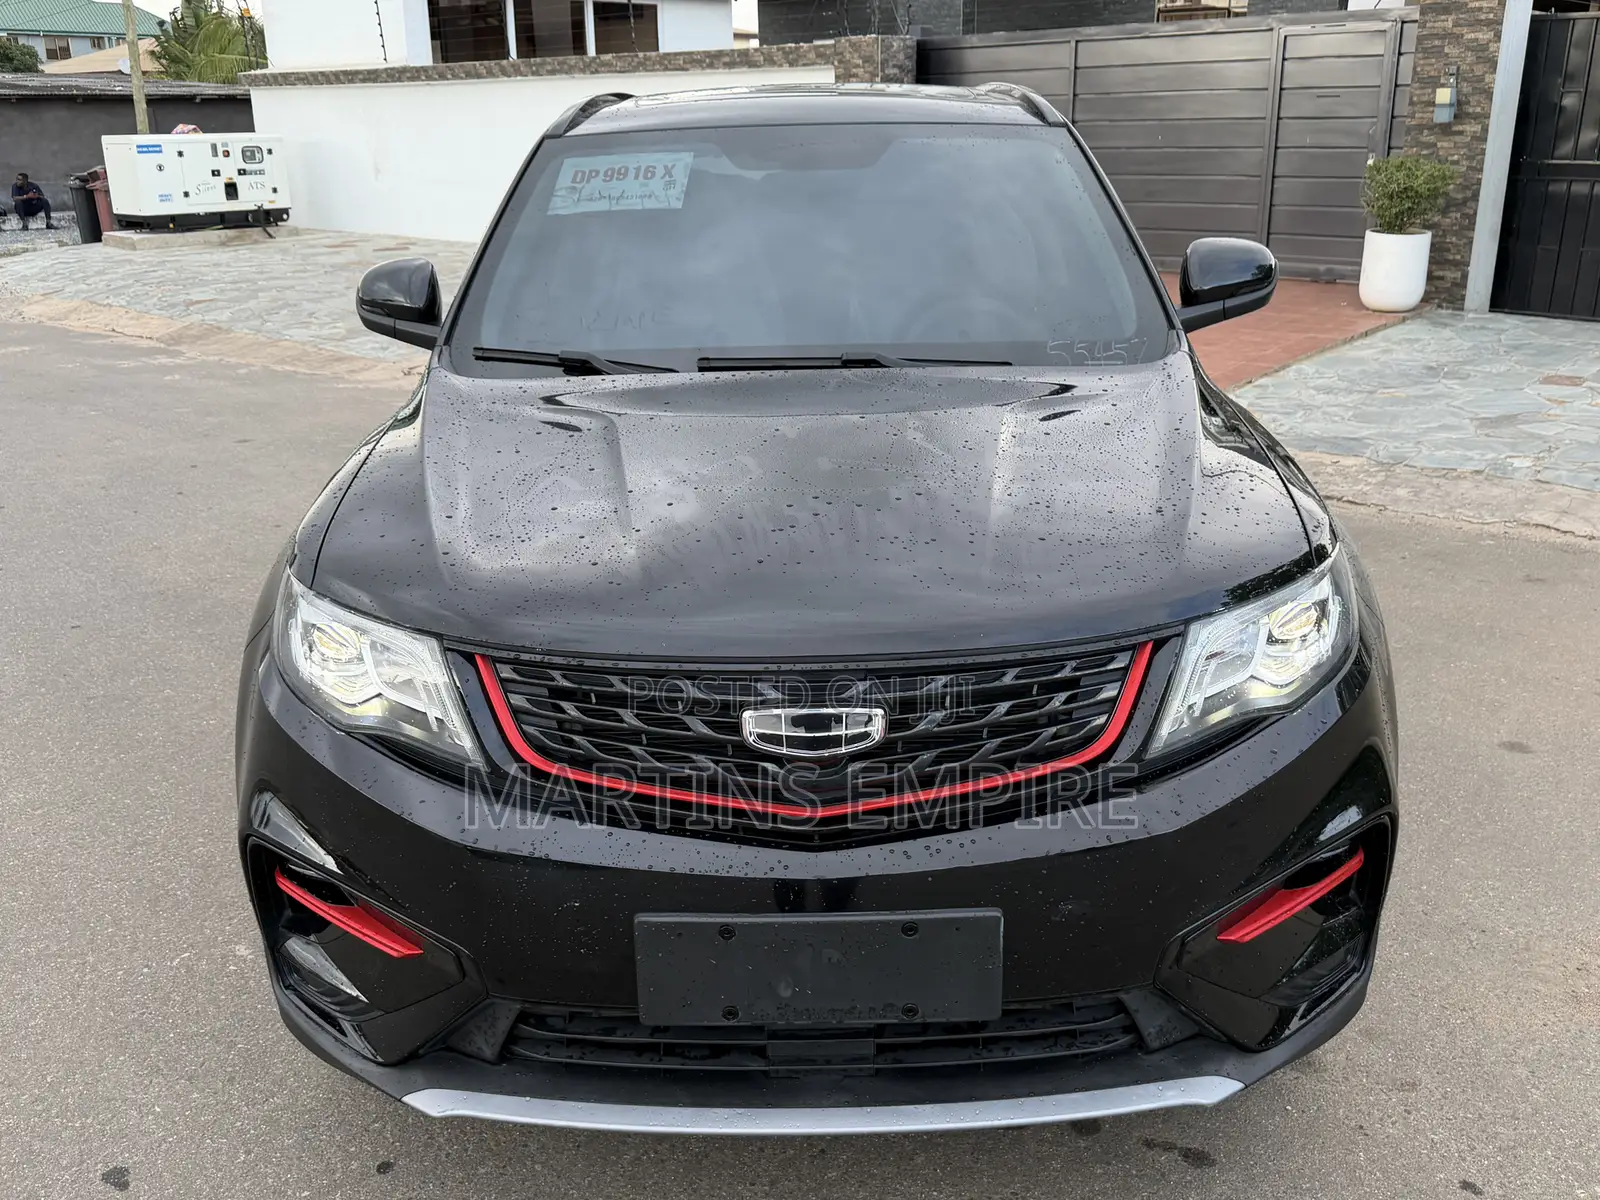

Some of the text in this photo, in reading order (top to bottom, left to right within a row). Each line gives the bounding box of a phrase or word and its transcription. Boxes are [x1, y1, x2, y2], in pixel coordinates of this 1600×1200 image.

[570, 163, 676, 185] DP 9916 X
[248, 181, 266, 191] ATS
